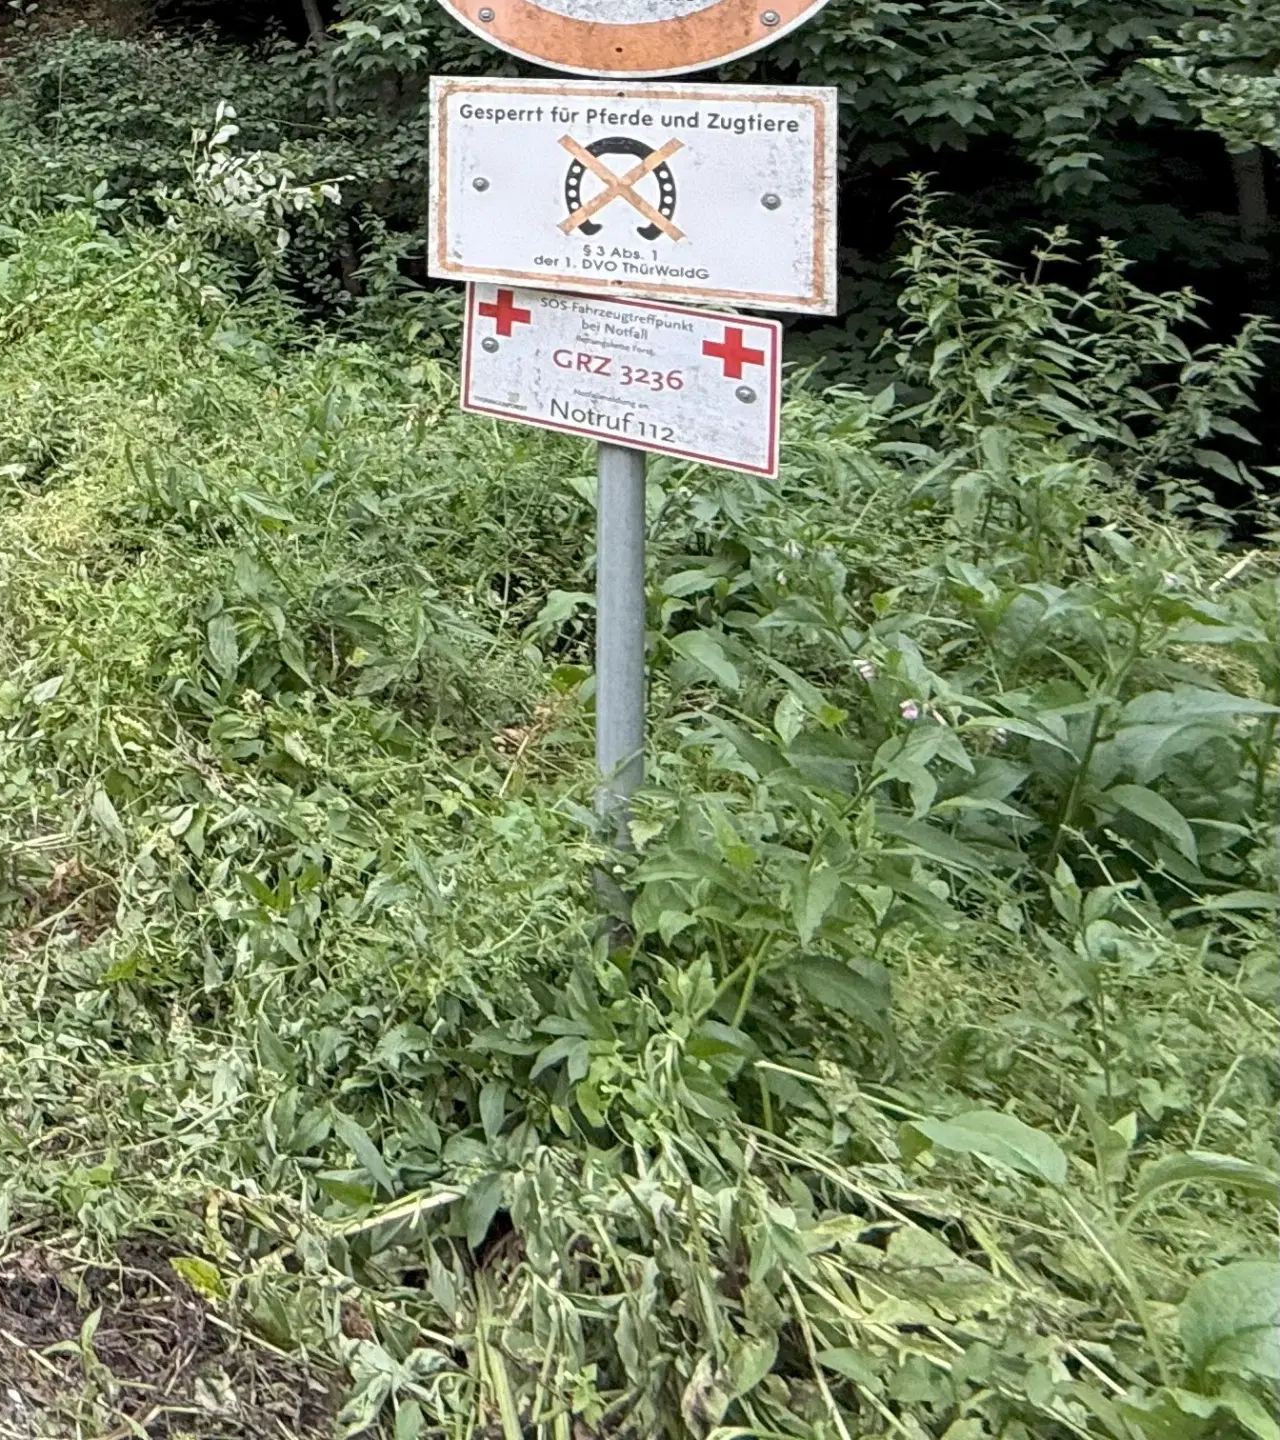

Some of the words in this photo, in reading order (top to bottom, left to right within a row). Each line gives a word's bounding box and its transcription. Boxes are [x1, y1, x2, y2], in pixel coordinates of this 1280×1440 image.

[459, 103, 544, 124] Gesperrt
[550, 106, 580, 123] für
[586, 107, 654, 127] Pferde
[660, 111, 700, 129] und
[706, 112, 800, 135] Zugtiere
[582, 244, 591, 257] §
[595, 245, 606, 257] 3
[610, 247, 645, 260] Abs.
[651, 249, 658, 261] 1
[533, 255, 559, 267] der
[565, 256, 578, 269] 1.
[582, 258, 618, 272] DVO
[622, 261, 711, 280] ThürWaldG
[581, 318, 601, 333] bei
[604, 322, 649, 341] Notfall
[552, 348, 612, 377] GRZ
[619, 365, 684, 392] 3236
[550, 398, 635, 433] Notruf
[637, 420, 676, 444] 112
